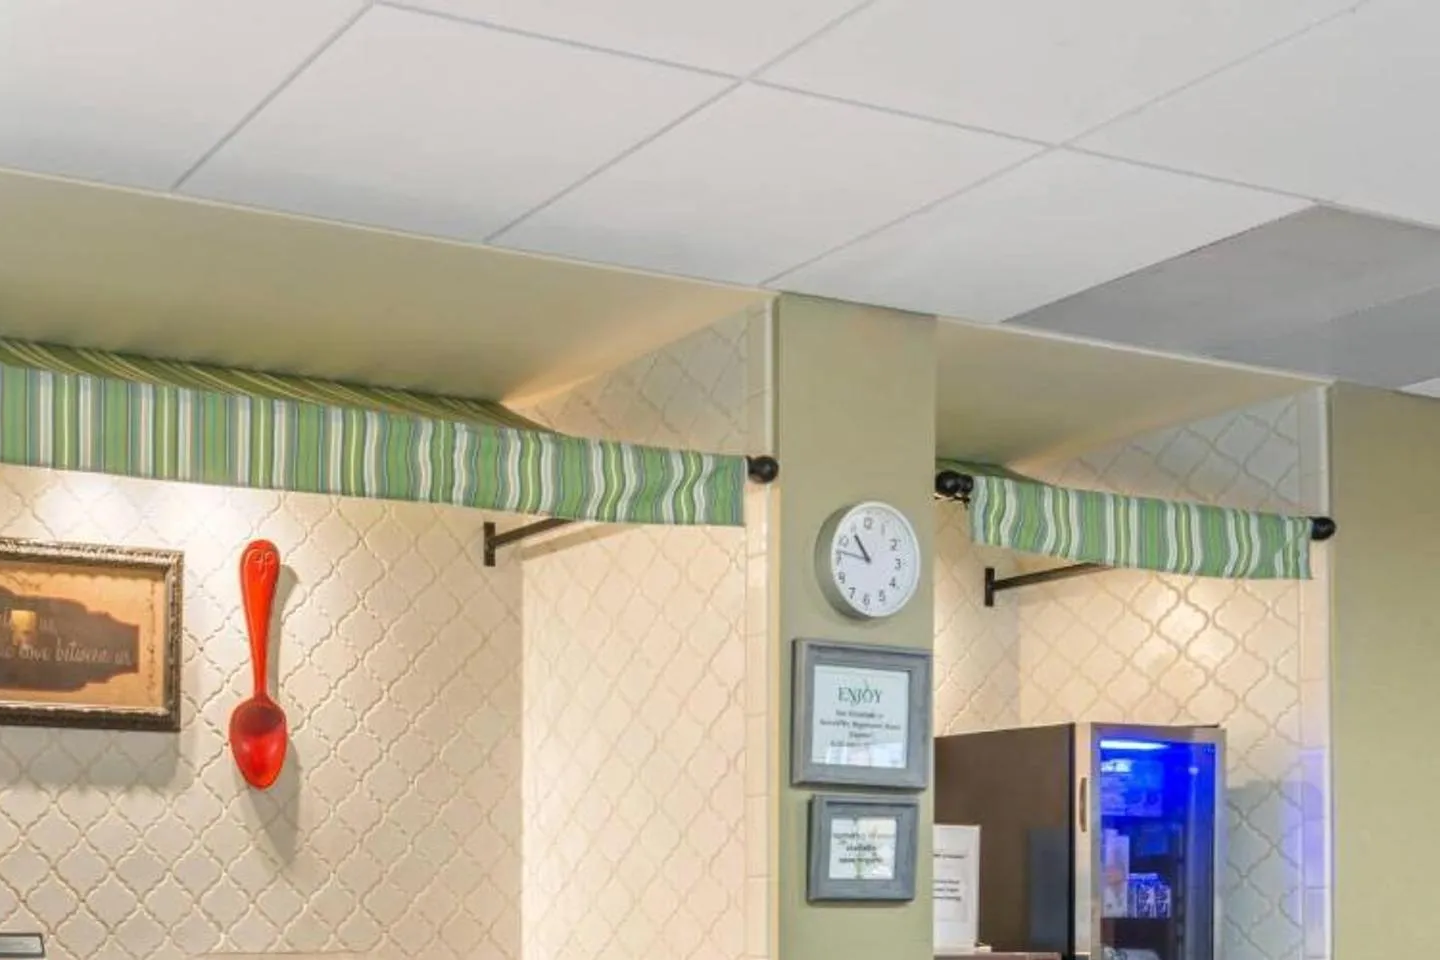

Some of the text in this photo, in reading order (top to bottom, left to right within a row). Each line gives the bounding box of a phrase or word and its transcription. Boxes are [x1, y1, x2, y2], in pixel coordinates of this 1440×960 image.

[889, 538, 898, 551] 2
[894, 558, 902, 571] 3
[888, 576, 896, 588] 4
[848, 586, 856, 599] 7
[878, 589, 886, 602] 5
[862, 593, 871, 606] 6
[55, 637, 110, 664] between
[837, 686, 883, 706] ENJOY
